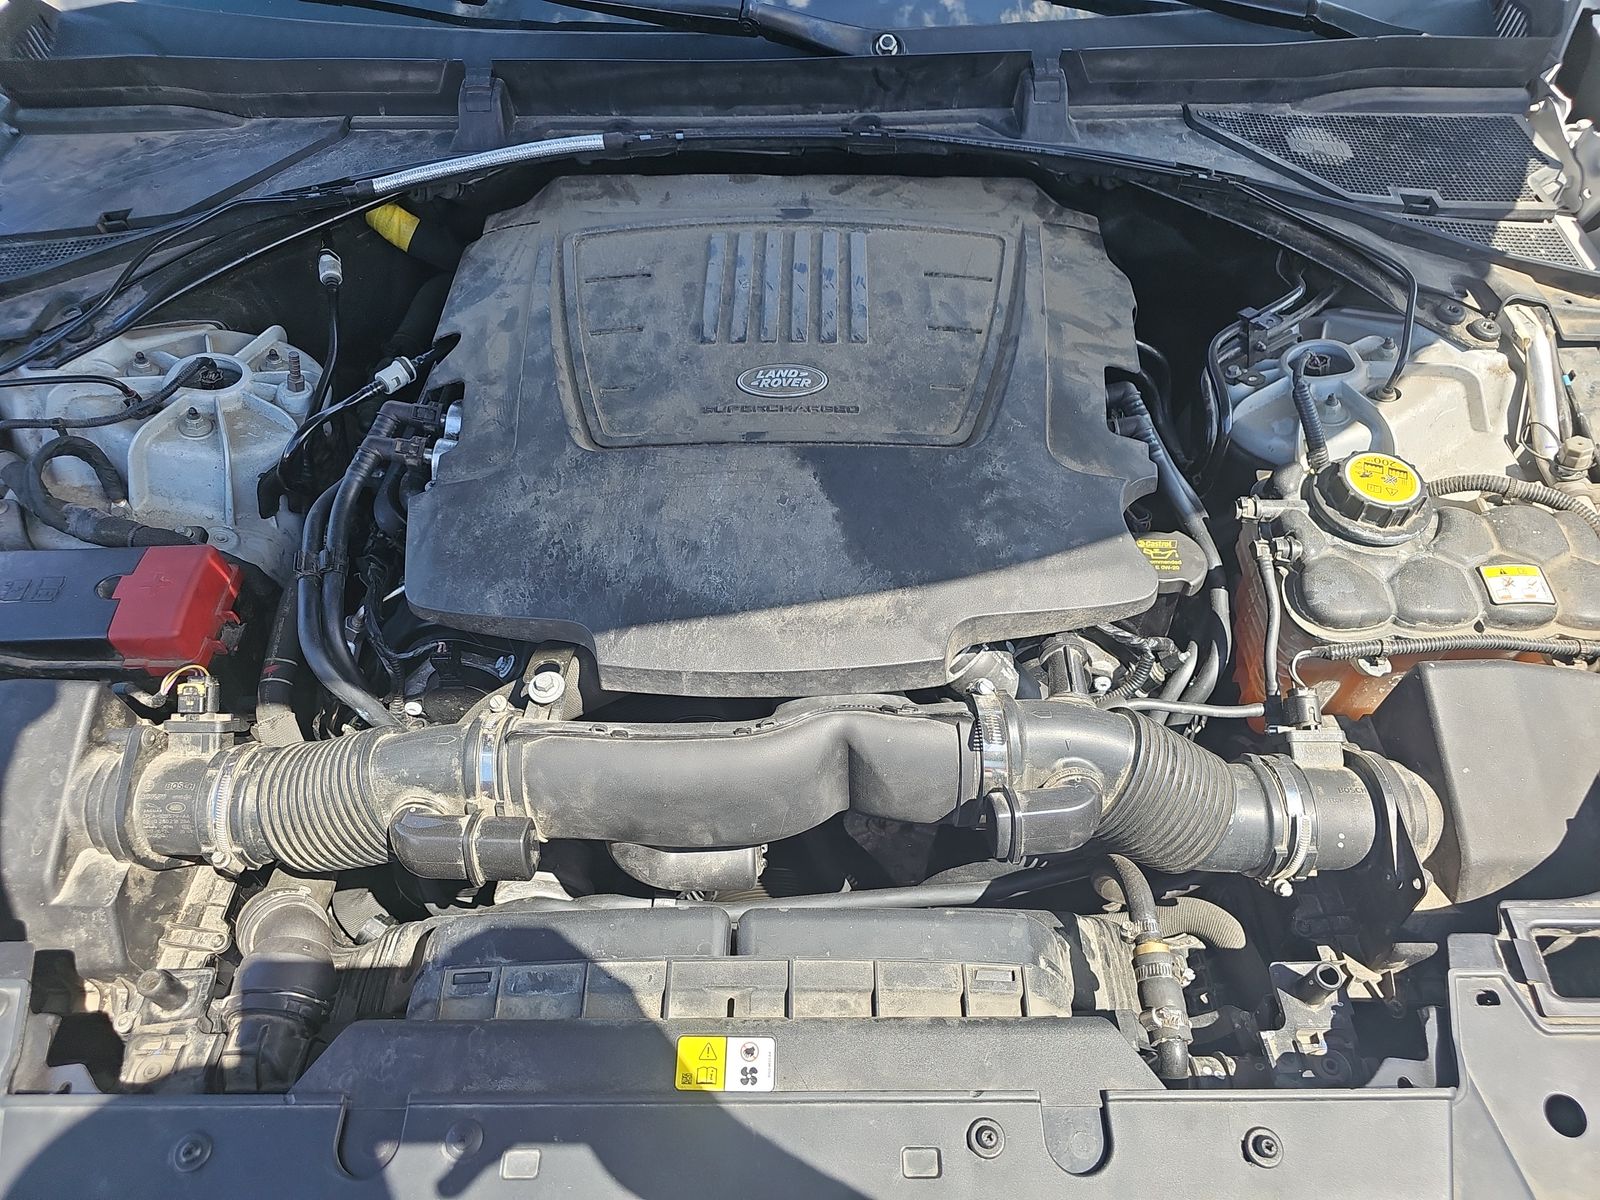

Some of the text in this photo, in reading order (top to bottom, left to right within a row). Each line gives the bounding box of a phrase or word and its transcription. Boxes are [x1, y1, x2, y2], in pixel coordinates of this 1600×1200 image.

[756, 369, 798, 379] LAND
[759, 379, 812, 388] ROVER
[702, 404, 860, 414] SUPERCHARGED
[165, 782, 196, 791] BOSCH
